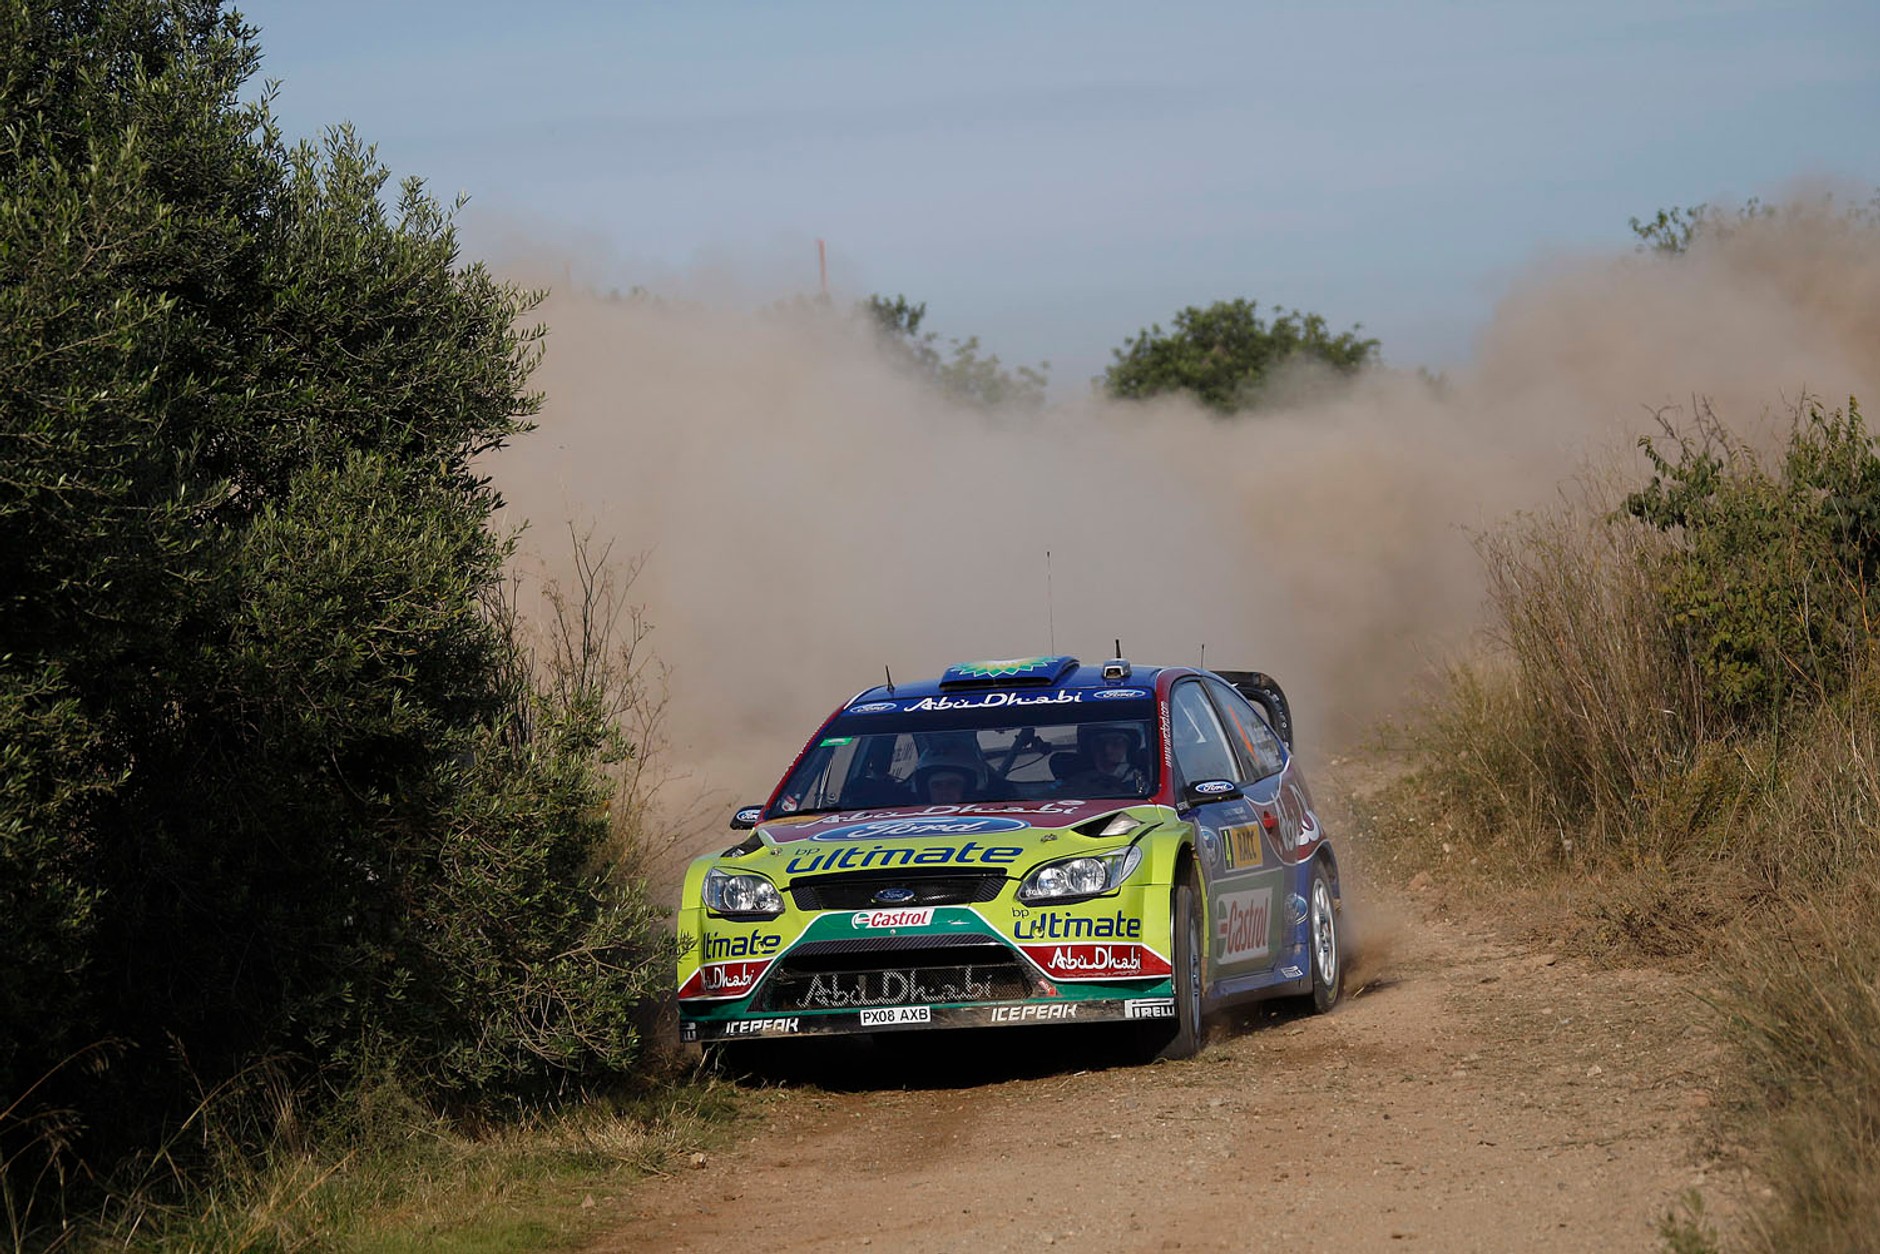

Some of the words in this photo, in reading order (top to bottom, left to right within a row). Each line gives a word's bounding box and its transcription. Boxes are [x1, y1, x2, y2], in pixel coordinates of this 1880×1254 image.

[982, 690, 1082, 706] Dhabi
[848, 818, 990, 838] Ford
[786, 842, 1023, 874] ultimate
[871, 911, 928, 927] Castrol
[1012, 908, 1029, 918] bp
[1014, 911, 1141, 939] ultimate
[1227, 897, 1269, 955] Castrol
[1094, 946, 1141, 970] Dhabi
[863, 1010, 895, 1024] PX08
[900, 1008, 929, 1022] AXB
[991, 1003, 1079, 1023] ICEPEAK
